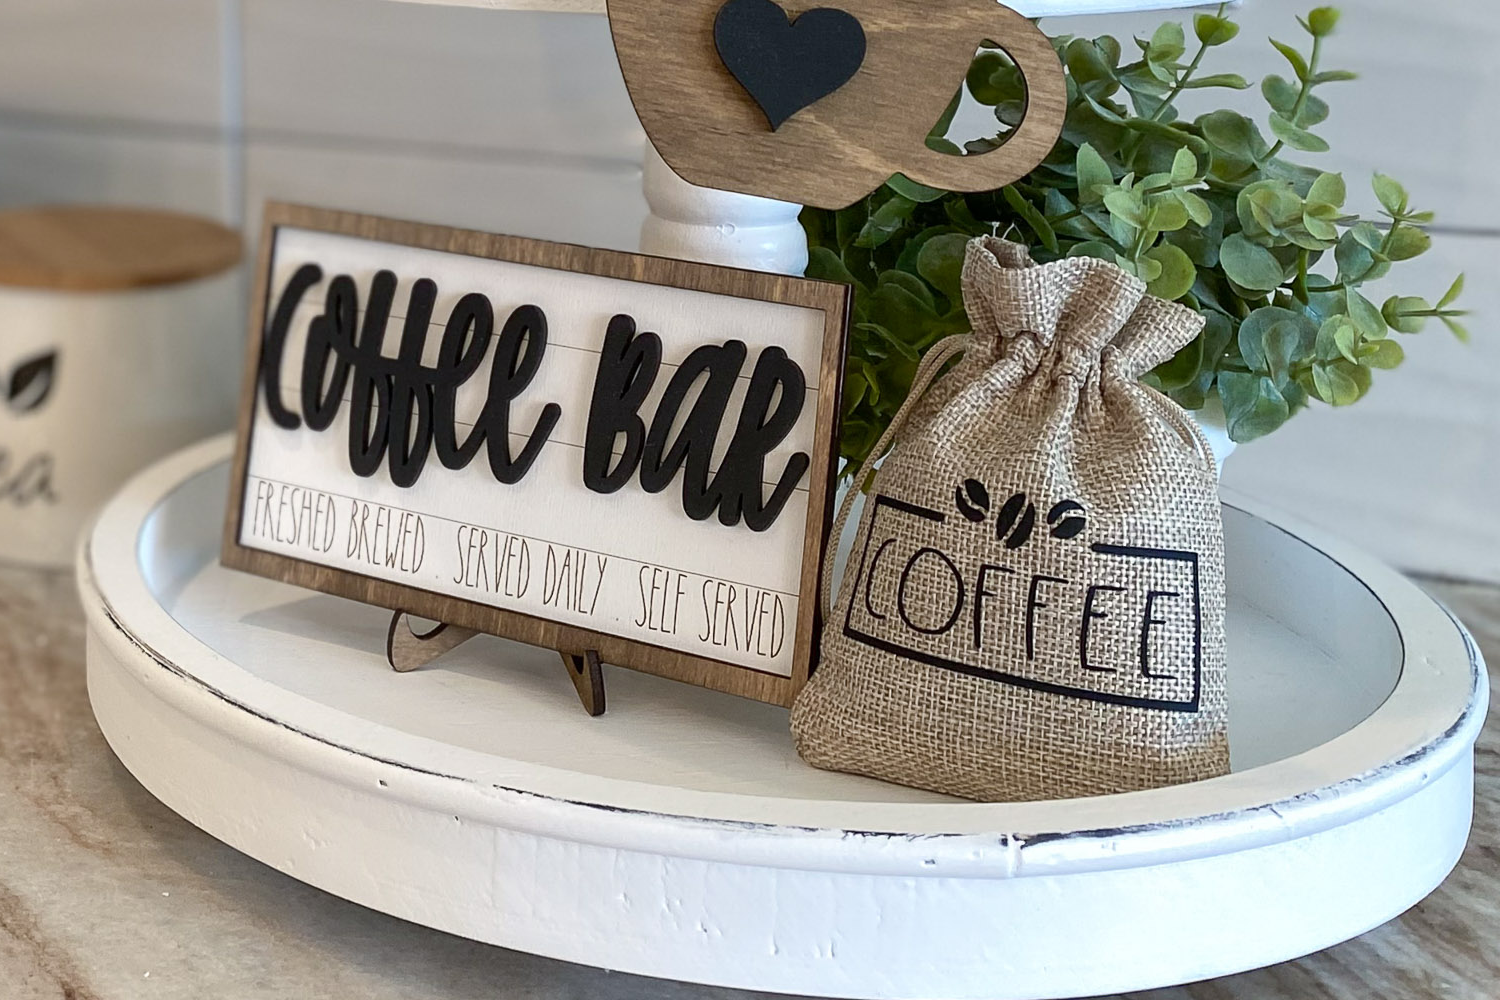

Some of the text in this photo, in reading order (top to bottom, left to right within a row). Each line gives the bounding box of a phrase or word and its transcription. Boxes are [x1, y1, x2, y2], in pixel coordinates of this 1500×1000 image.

[263, 262, 562, 489] Coffee
[253, 480, 785, 658] FRESHED BREWED SERVED DAILY SELF SERVED
[865, 537, 1181, 682] COFFEE
